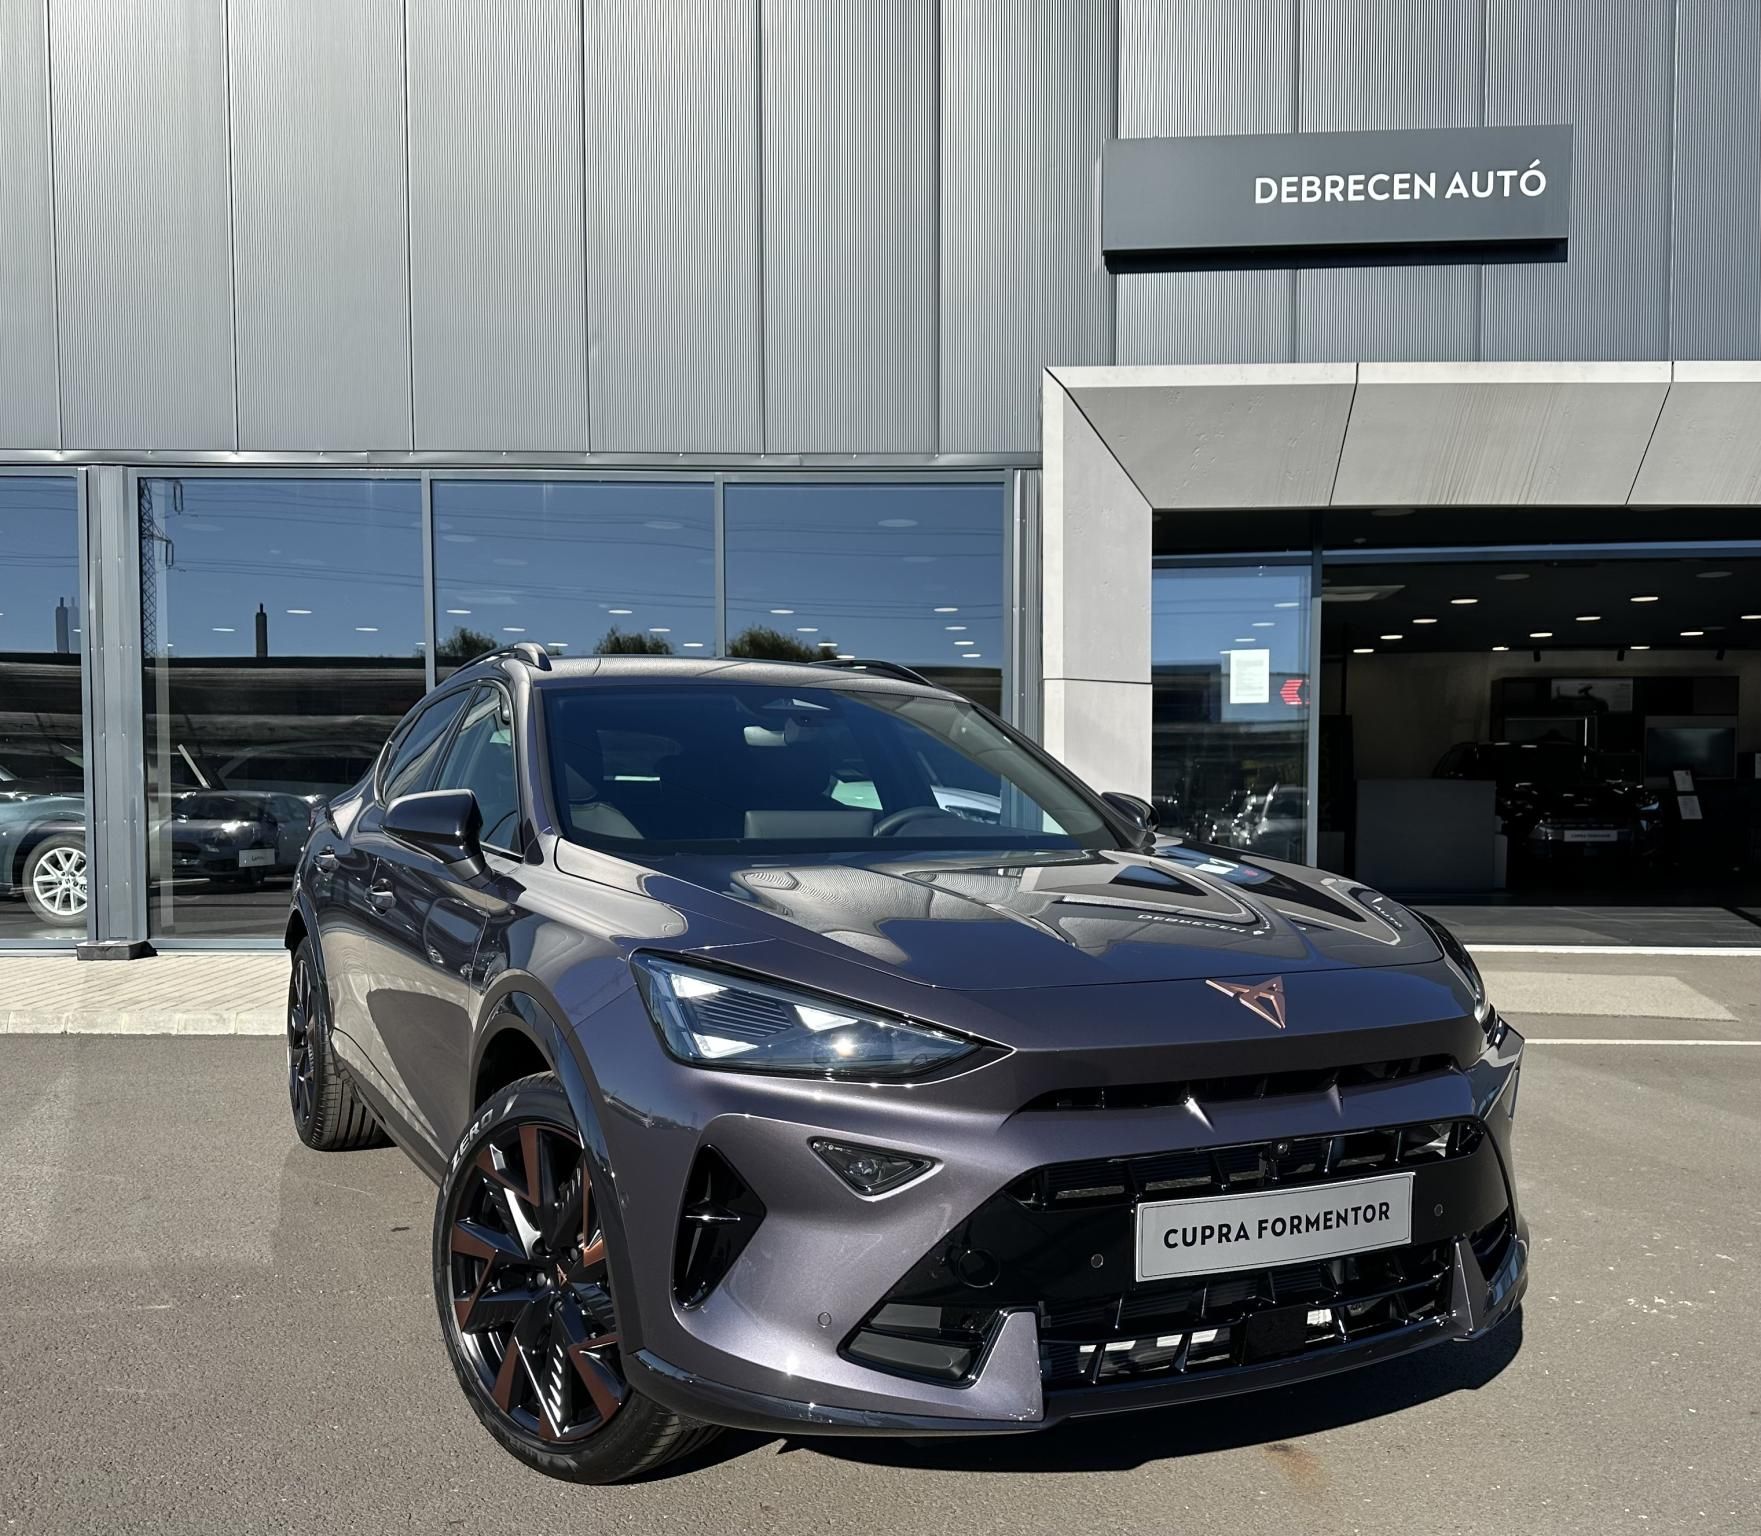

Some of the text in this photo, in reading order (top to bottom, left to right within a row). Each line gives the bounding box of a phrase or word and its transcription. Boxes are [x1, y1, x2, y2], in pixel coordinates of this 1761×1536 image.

[1254, 159, 1547, 204] DEBRECEN AUTÓ
[451, 1108, 494, 1173] ZERO
[1163, 1201, 1391, 1249] CUPRA FORMENTOR
